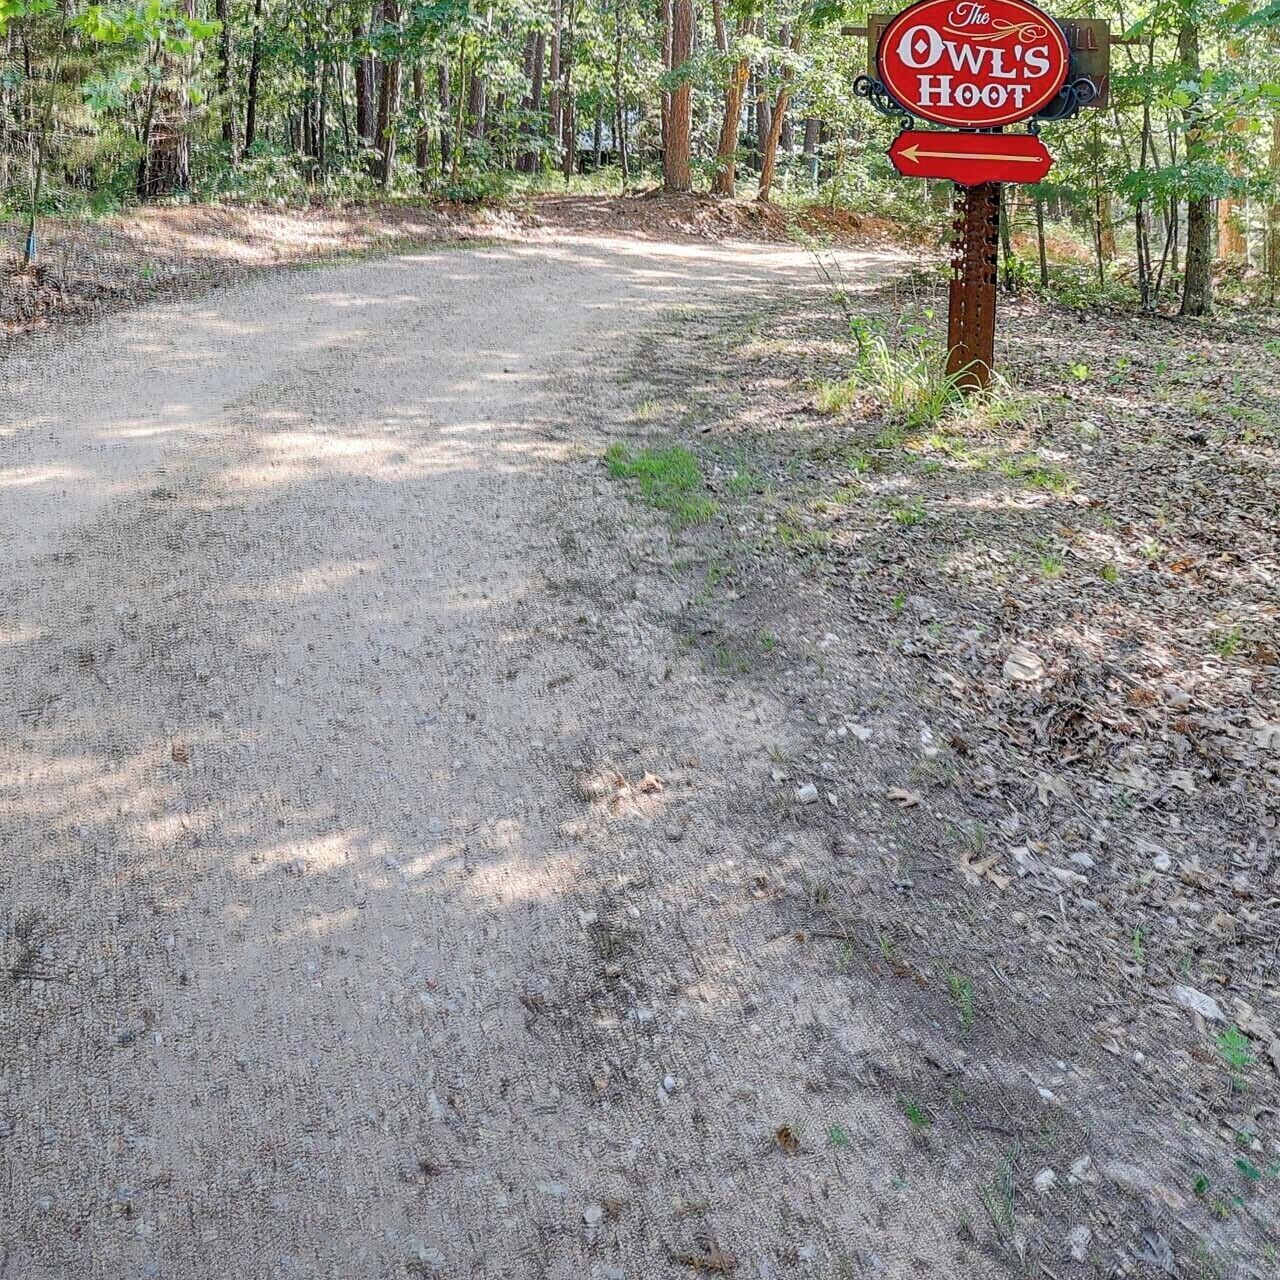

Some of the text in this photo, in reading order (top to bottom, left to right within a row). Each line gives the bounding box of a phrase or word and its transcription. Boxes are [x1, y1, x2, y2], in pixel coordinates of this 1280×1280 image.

[948, 1, 990, 27] The
[896, 25, 1050, 78] OWL'S
[916, 74, 1031, 108] HOOT
